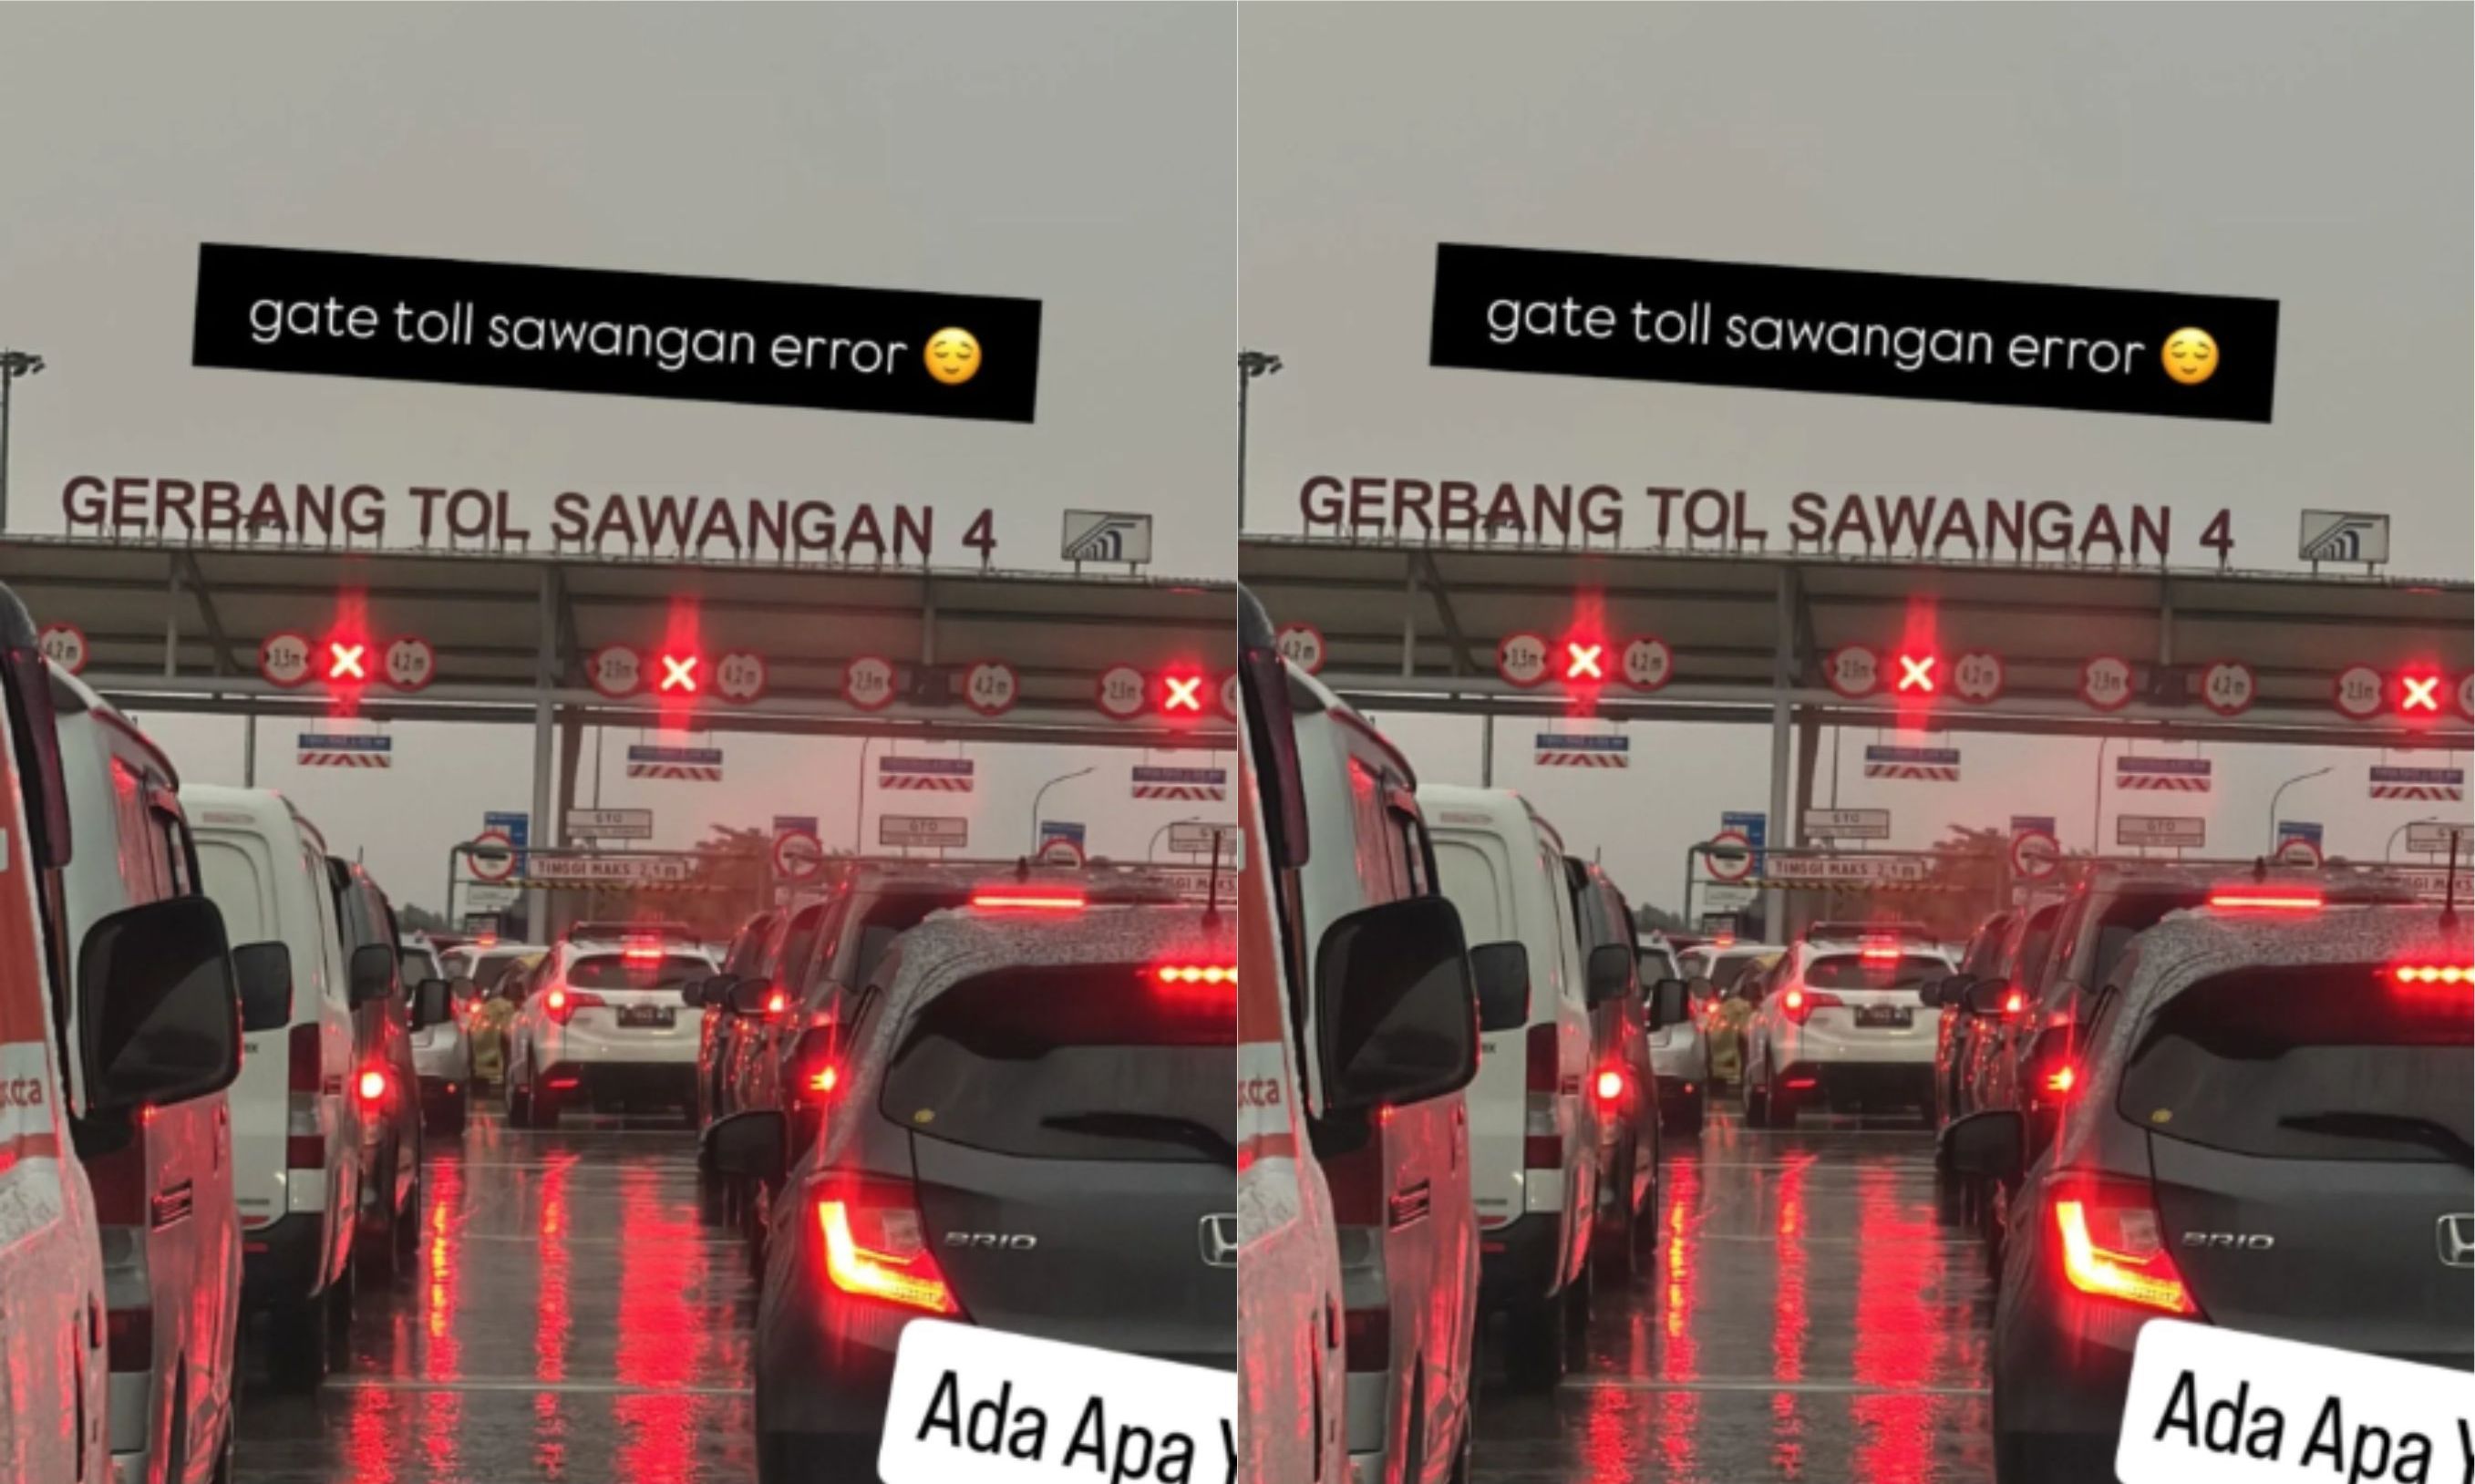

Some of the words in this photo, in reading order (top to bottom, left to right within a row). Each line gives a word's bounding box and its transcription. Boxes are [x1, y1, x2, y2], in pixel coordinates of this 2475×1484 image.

[62, 475, 386, 535] GERBANG
[408, 487, 531, 540] TOL
[550, 491, 933, 555] SAWANGAN
[962, 509, 997, 558] 4
[1299, 475, 1624, 535] GERBANG
[1645, 487, 1769, 540] TOL
[1787, 491, 2171, 555] SAWANGAN
[2199, 509, 2235, 558] 4
[944, 1231, 1037, 1250] BRIO
[2181, 1231, 2275, 1250] BRIO
